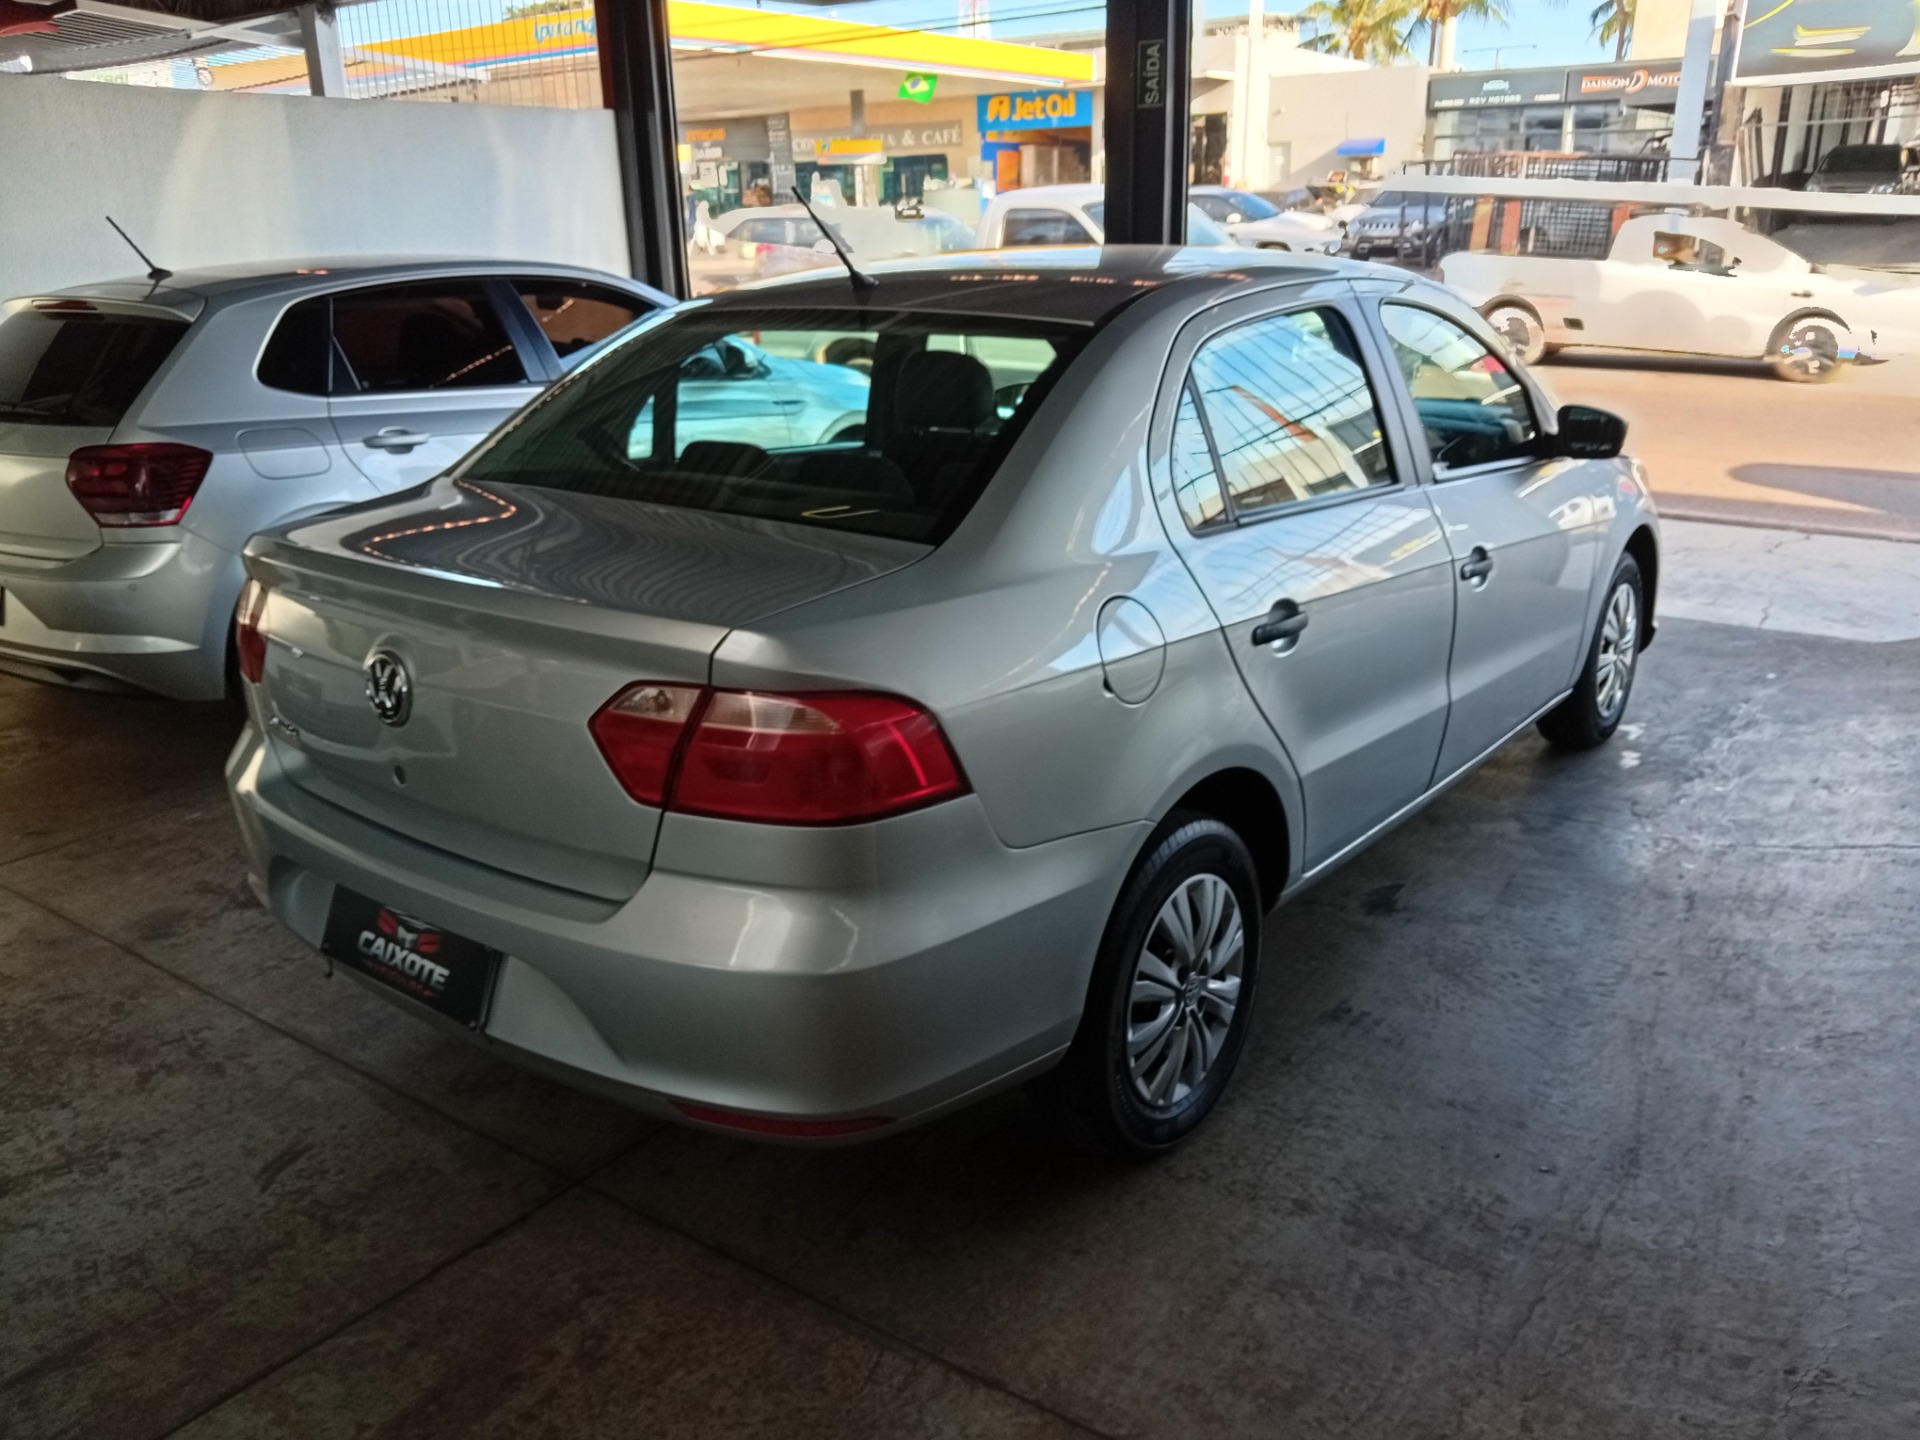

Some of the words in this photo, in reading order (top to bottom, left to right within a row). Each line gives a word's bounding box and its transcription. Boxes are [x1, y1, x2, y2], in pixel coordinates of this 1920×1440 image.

[1144, 44, 1160, 104] SAÍDA
[1581, 76, 1630, 90] DAISSON
[1647, 73, 1681, 87] MOTO
[922, 125, 962, 145] CAFÉ
[357, 930, 450, 990] CAIXOTE
